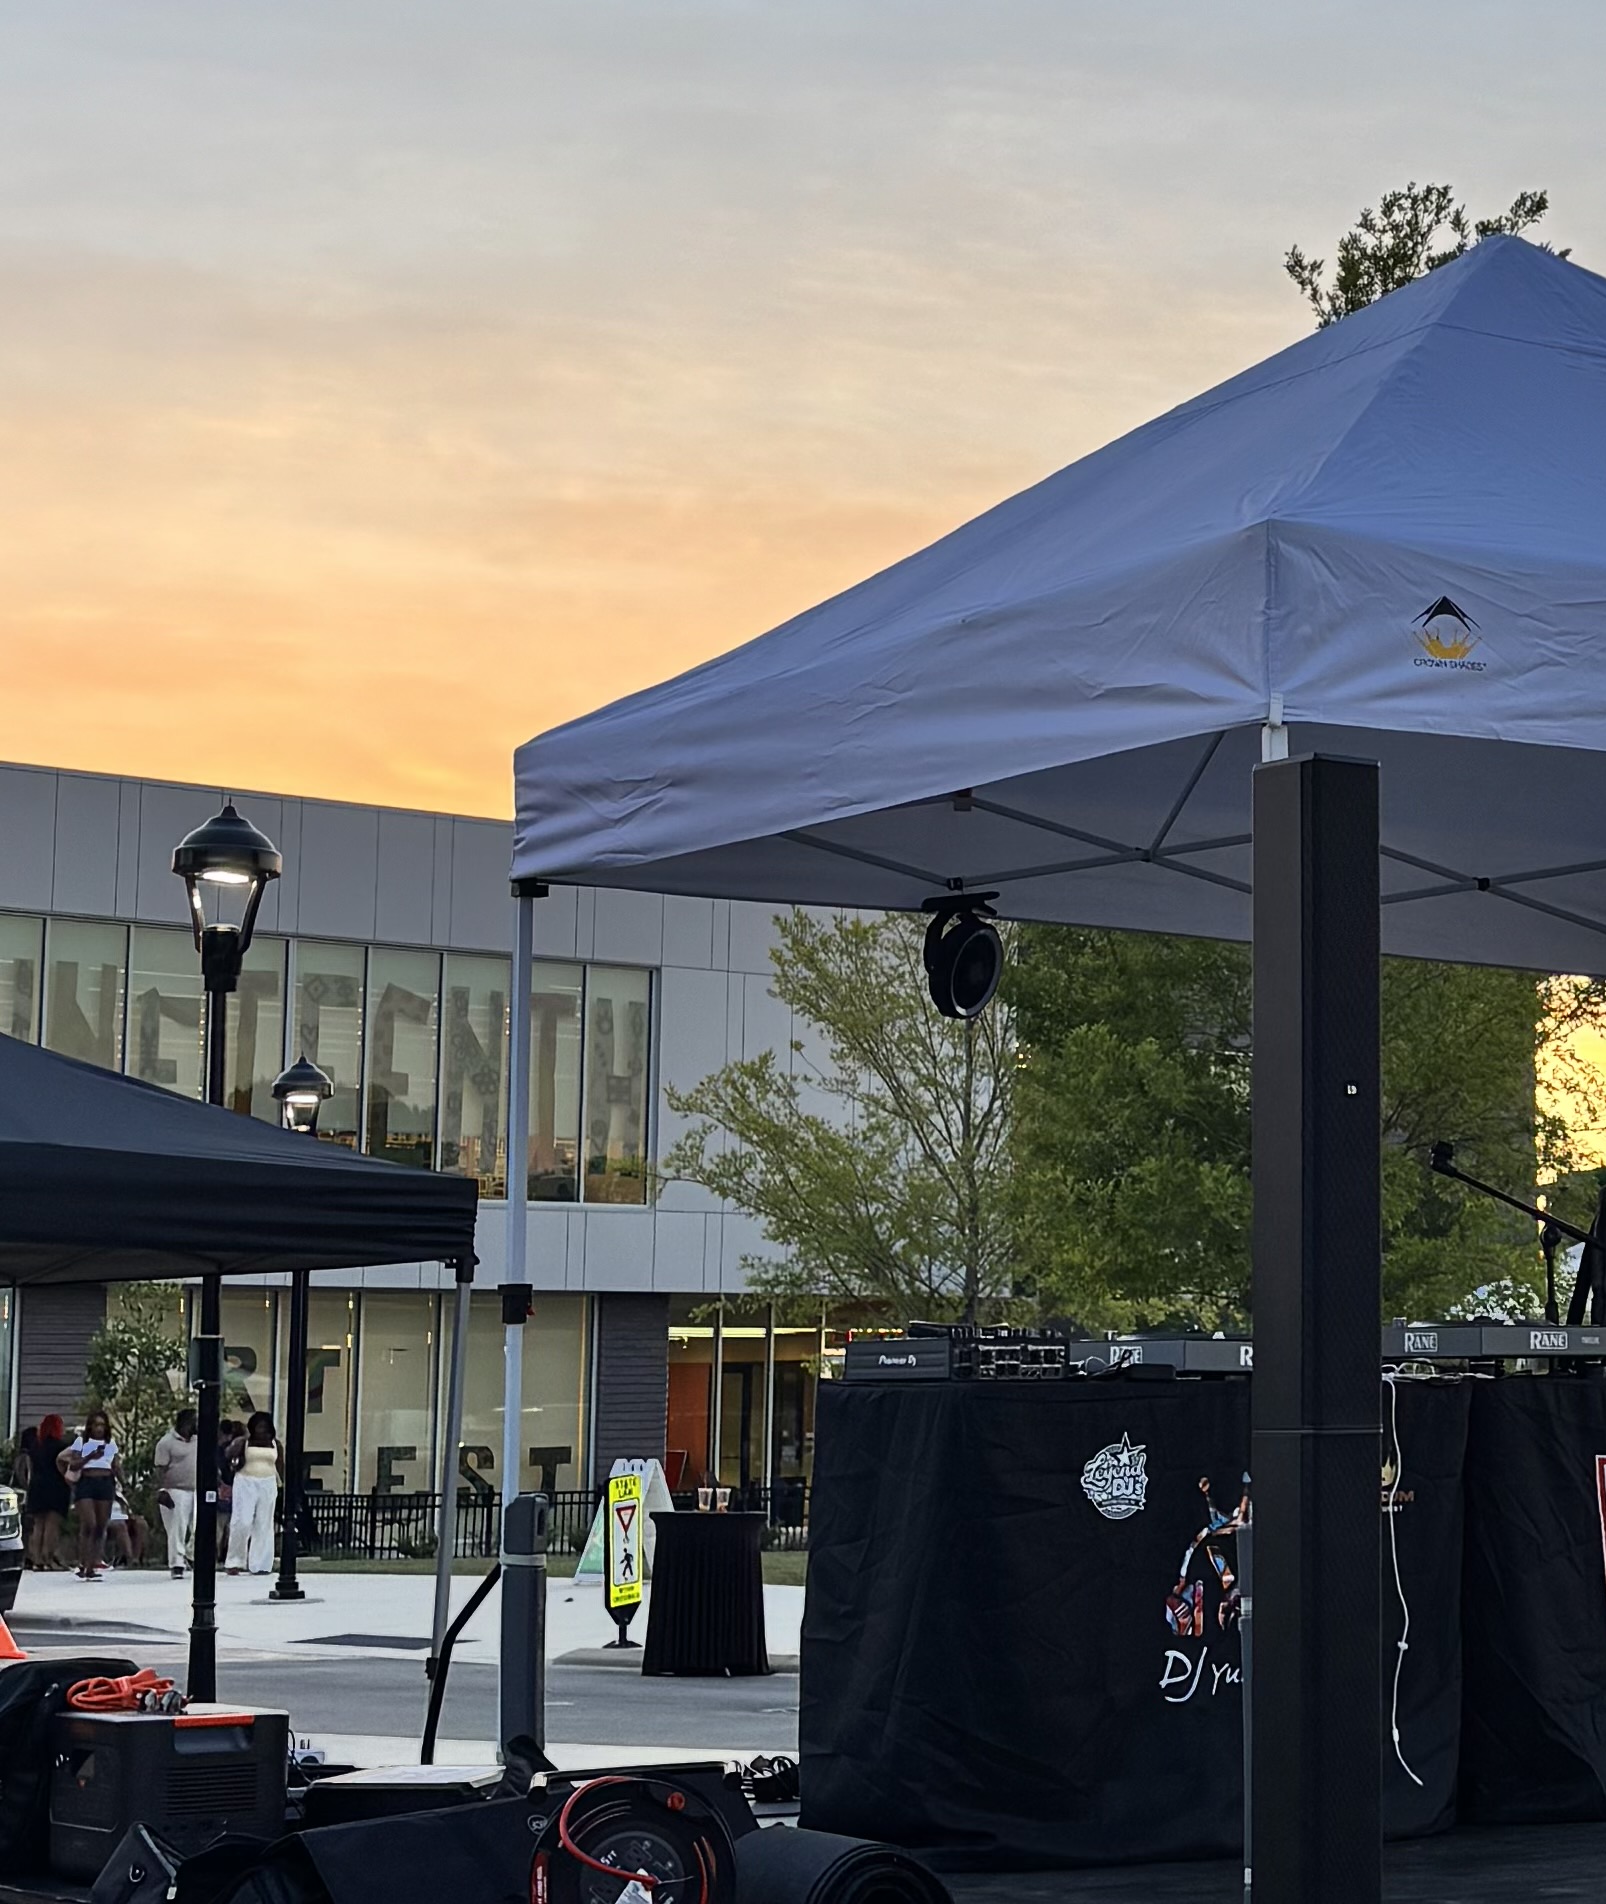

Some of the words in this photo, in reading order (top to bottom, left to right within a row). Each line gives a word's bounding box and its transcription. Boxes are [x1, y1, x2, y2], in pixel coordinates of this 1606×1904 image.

[1404, 1332, 1437, 1352] RANE
[1529, 1331, 1567, 1350] RANE
[1159, 1647, 1208, 1703] DJ
